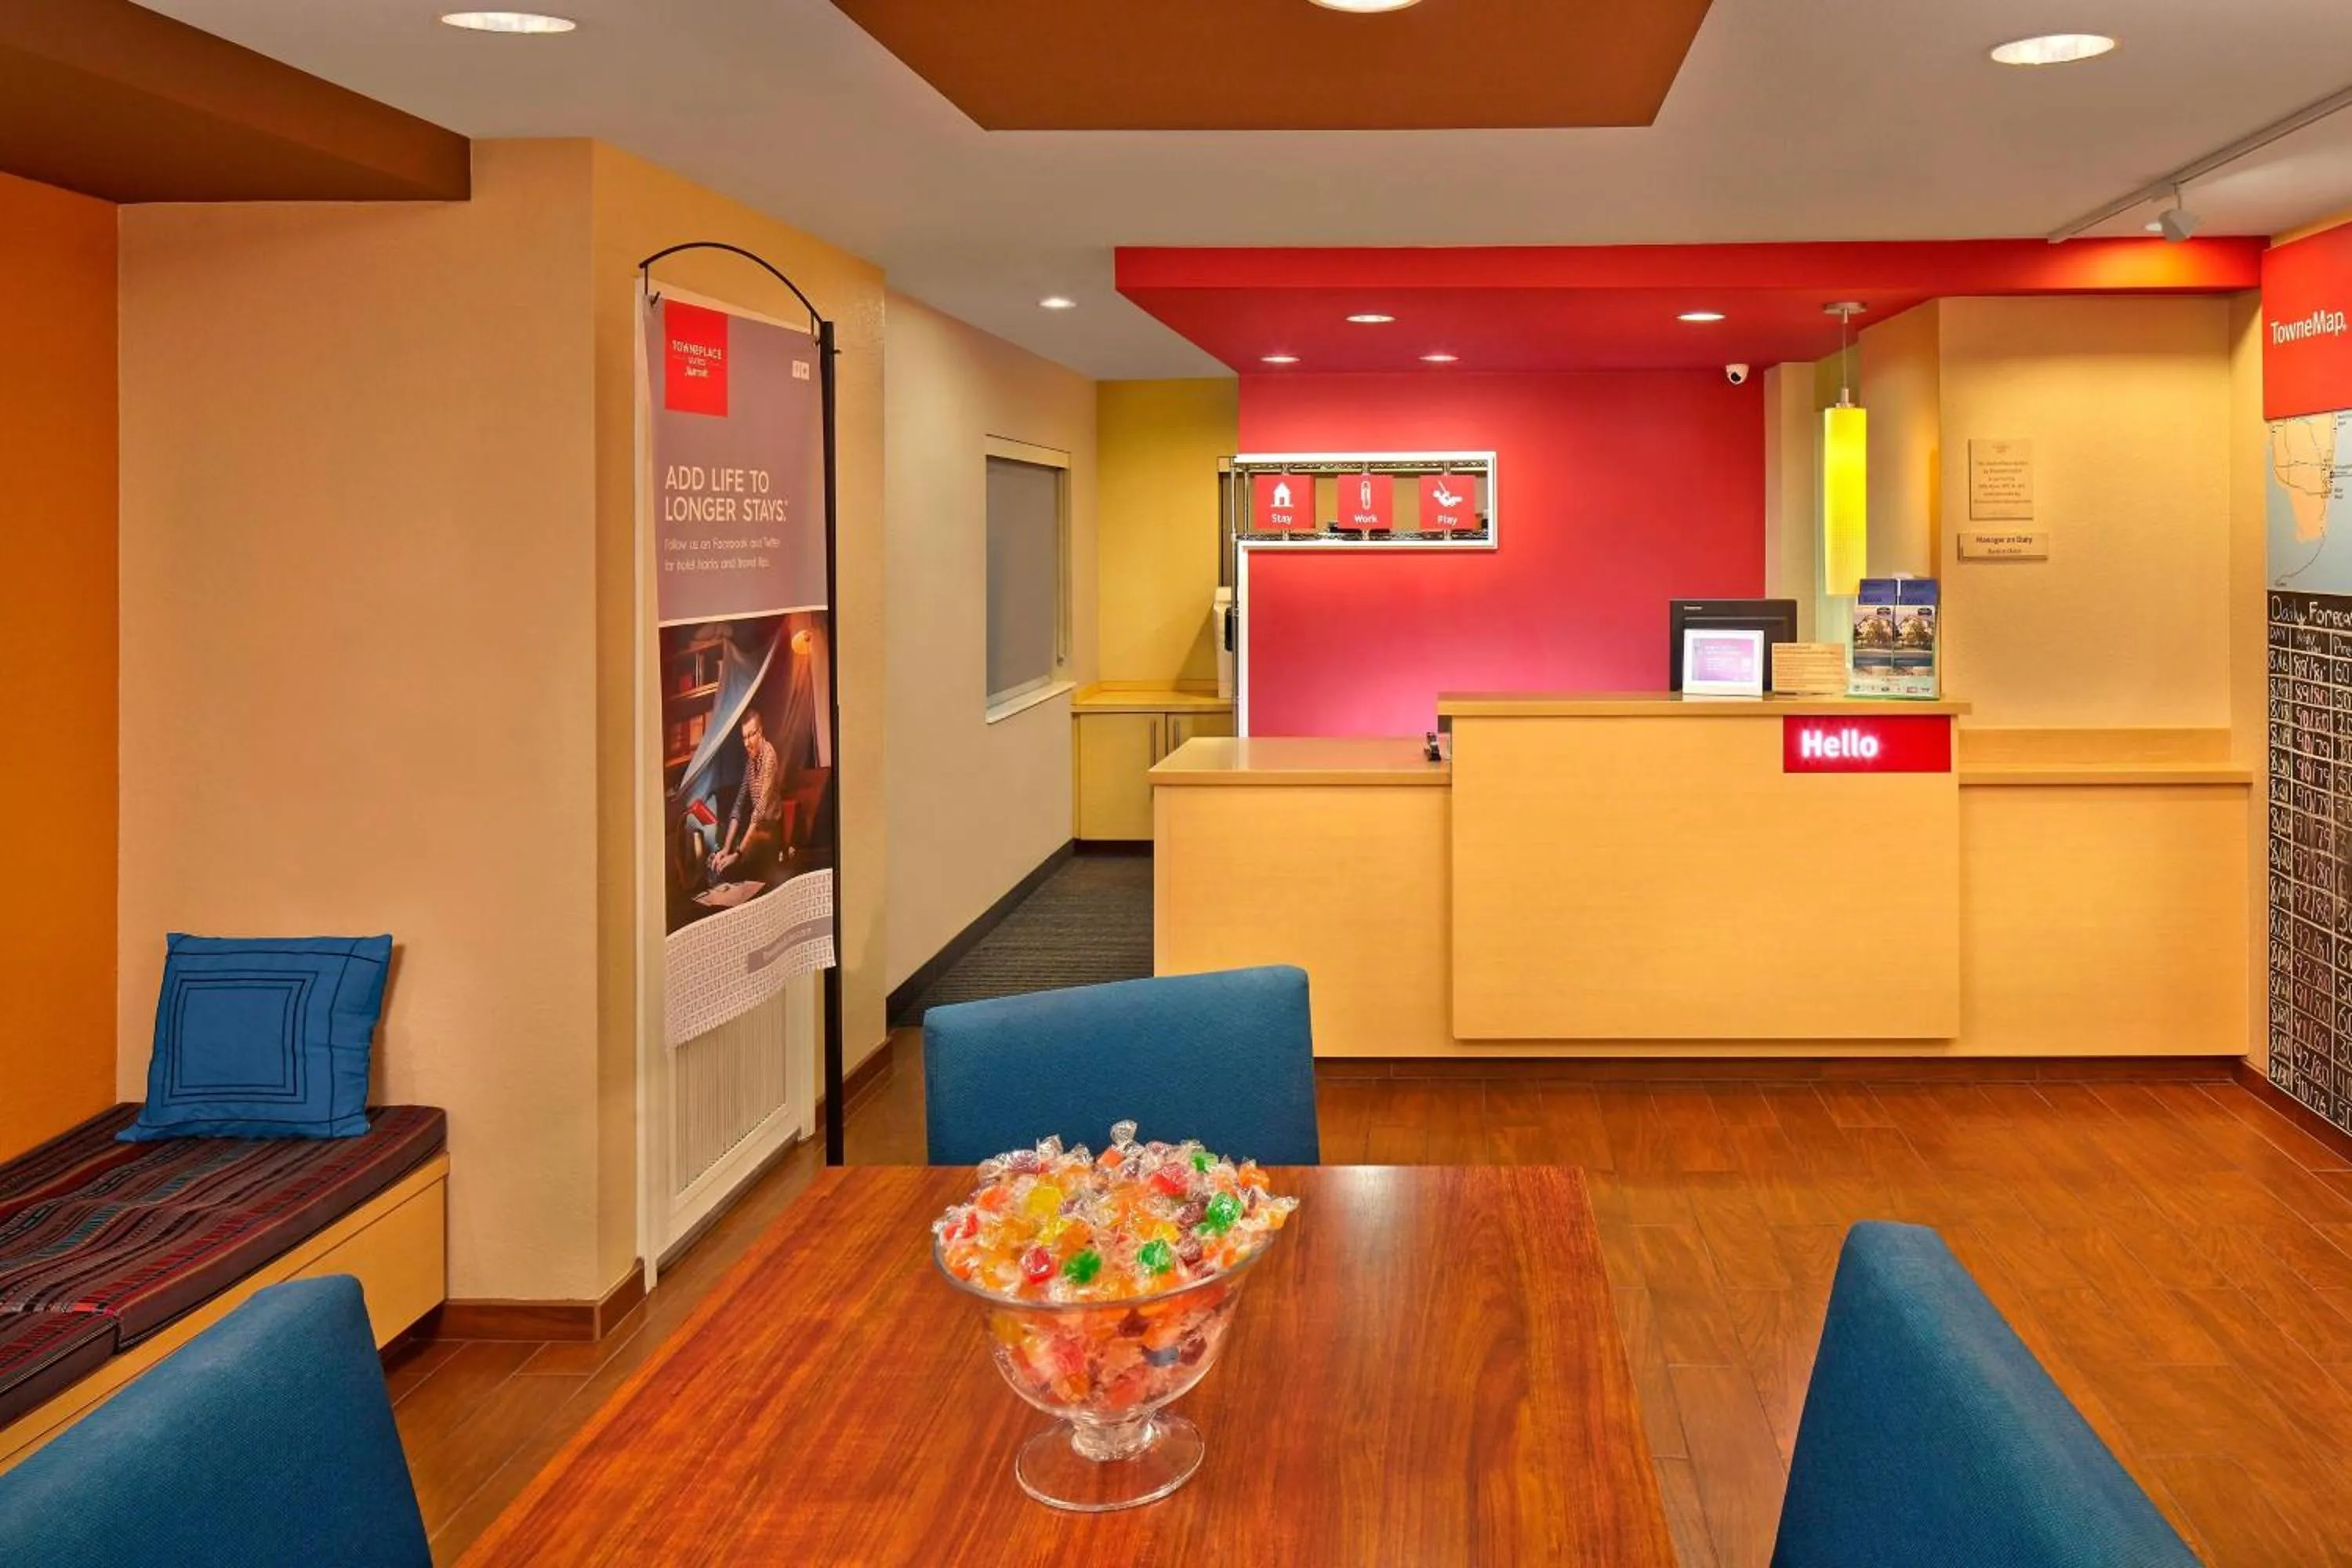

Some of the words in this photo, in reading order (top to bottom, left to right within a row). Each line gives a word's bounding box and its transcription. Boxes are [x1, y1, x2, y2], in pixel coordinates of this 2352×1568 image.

[665, 465, 705, 491] ADD
[712, 467, 744, 492] LIFE
[749, 470, 769, 493] TO
[665, 495, 736, 521] LONGER
[1271, 514, 1293, 525] Stay
[1354, 514, 1377, 523] Work
[1436, 515, 1457, 525] Play
[2271, 595, 2307, 630] Daily
[2309, 601, 2352, 627] Foreca
[1801, 729, 1878, 758] Hello
